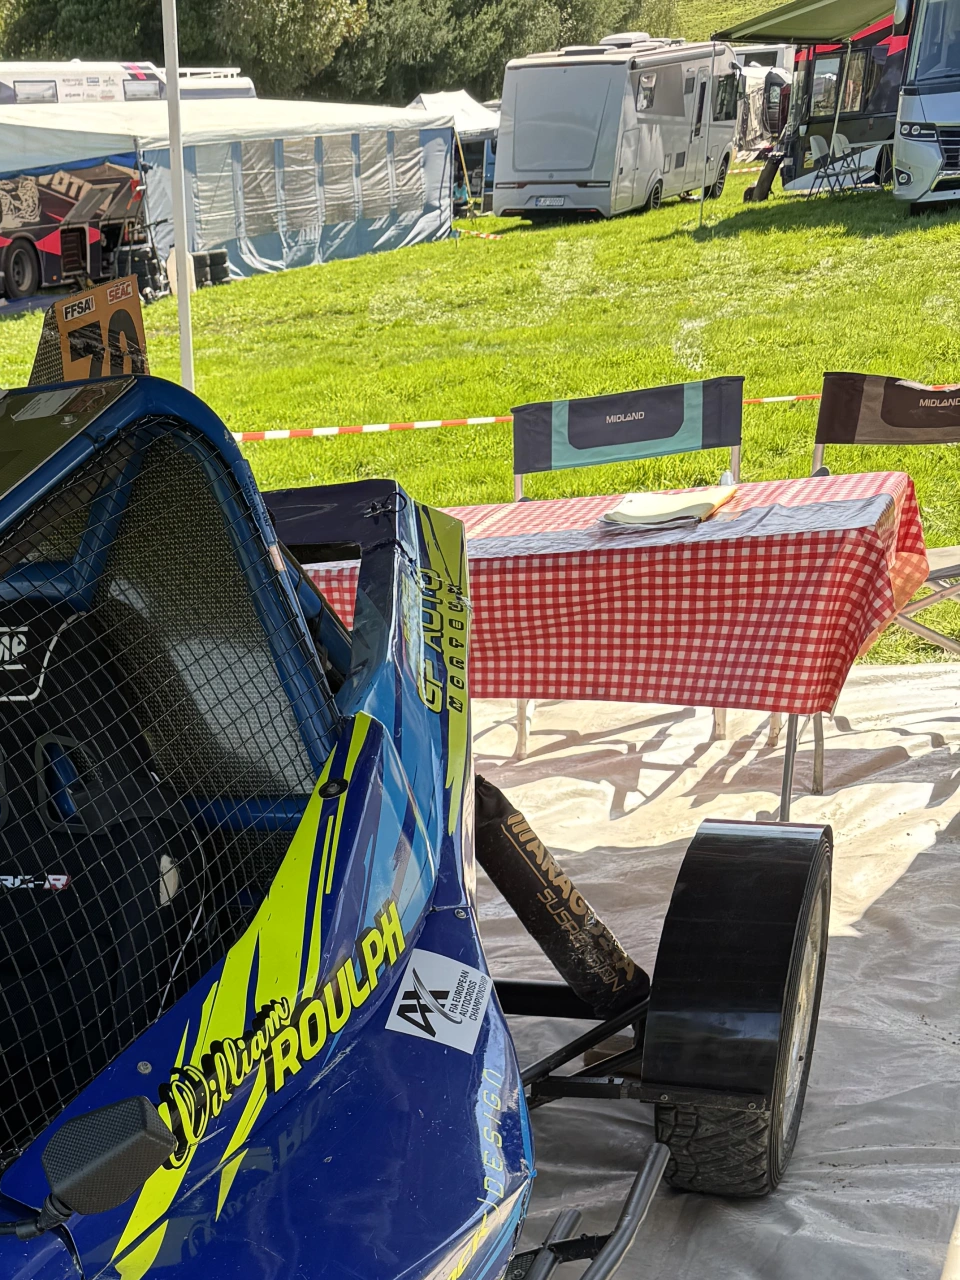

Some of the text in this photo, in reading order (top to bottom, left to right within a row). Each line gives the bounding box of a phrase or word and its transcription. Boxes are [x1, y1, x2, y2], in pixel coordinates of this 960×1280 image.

[64, 297, 91, 320] FFSA
[108, 283, 132, 302] SEAC
[605, 411, 645, 424] MIDLAND
[270, 900, 407, 1092] ROULPH
[453, 969, 470, 1004] EUROPEAN
[458, 979, 478, 1018] AUTOCROSS
[468, 975, 489, 1022] CHAMPIONSHIP
[157, 996, 290, 1168] William
